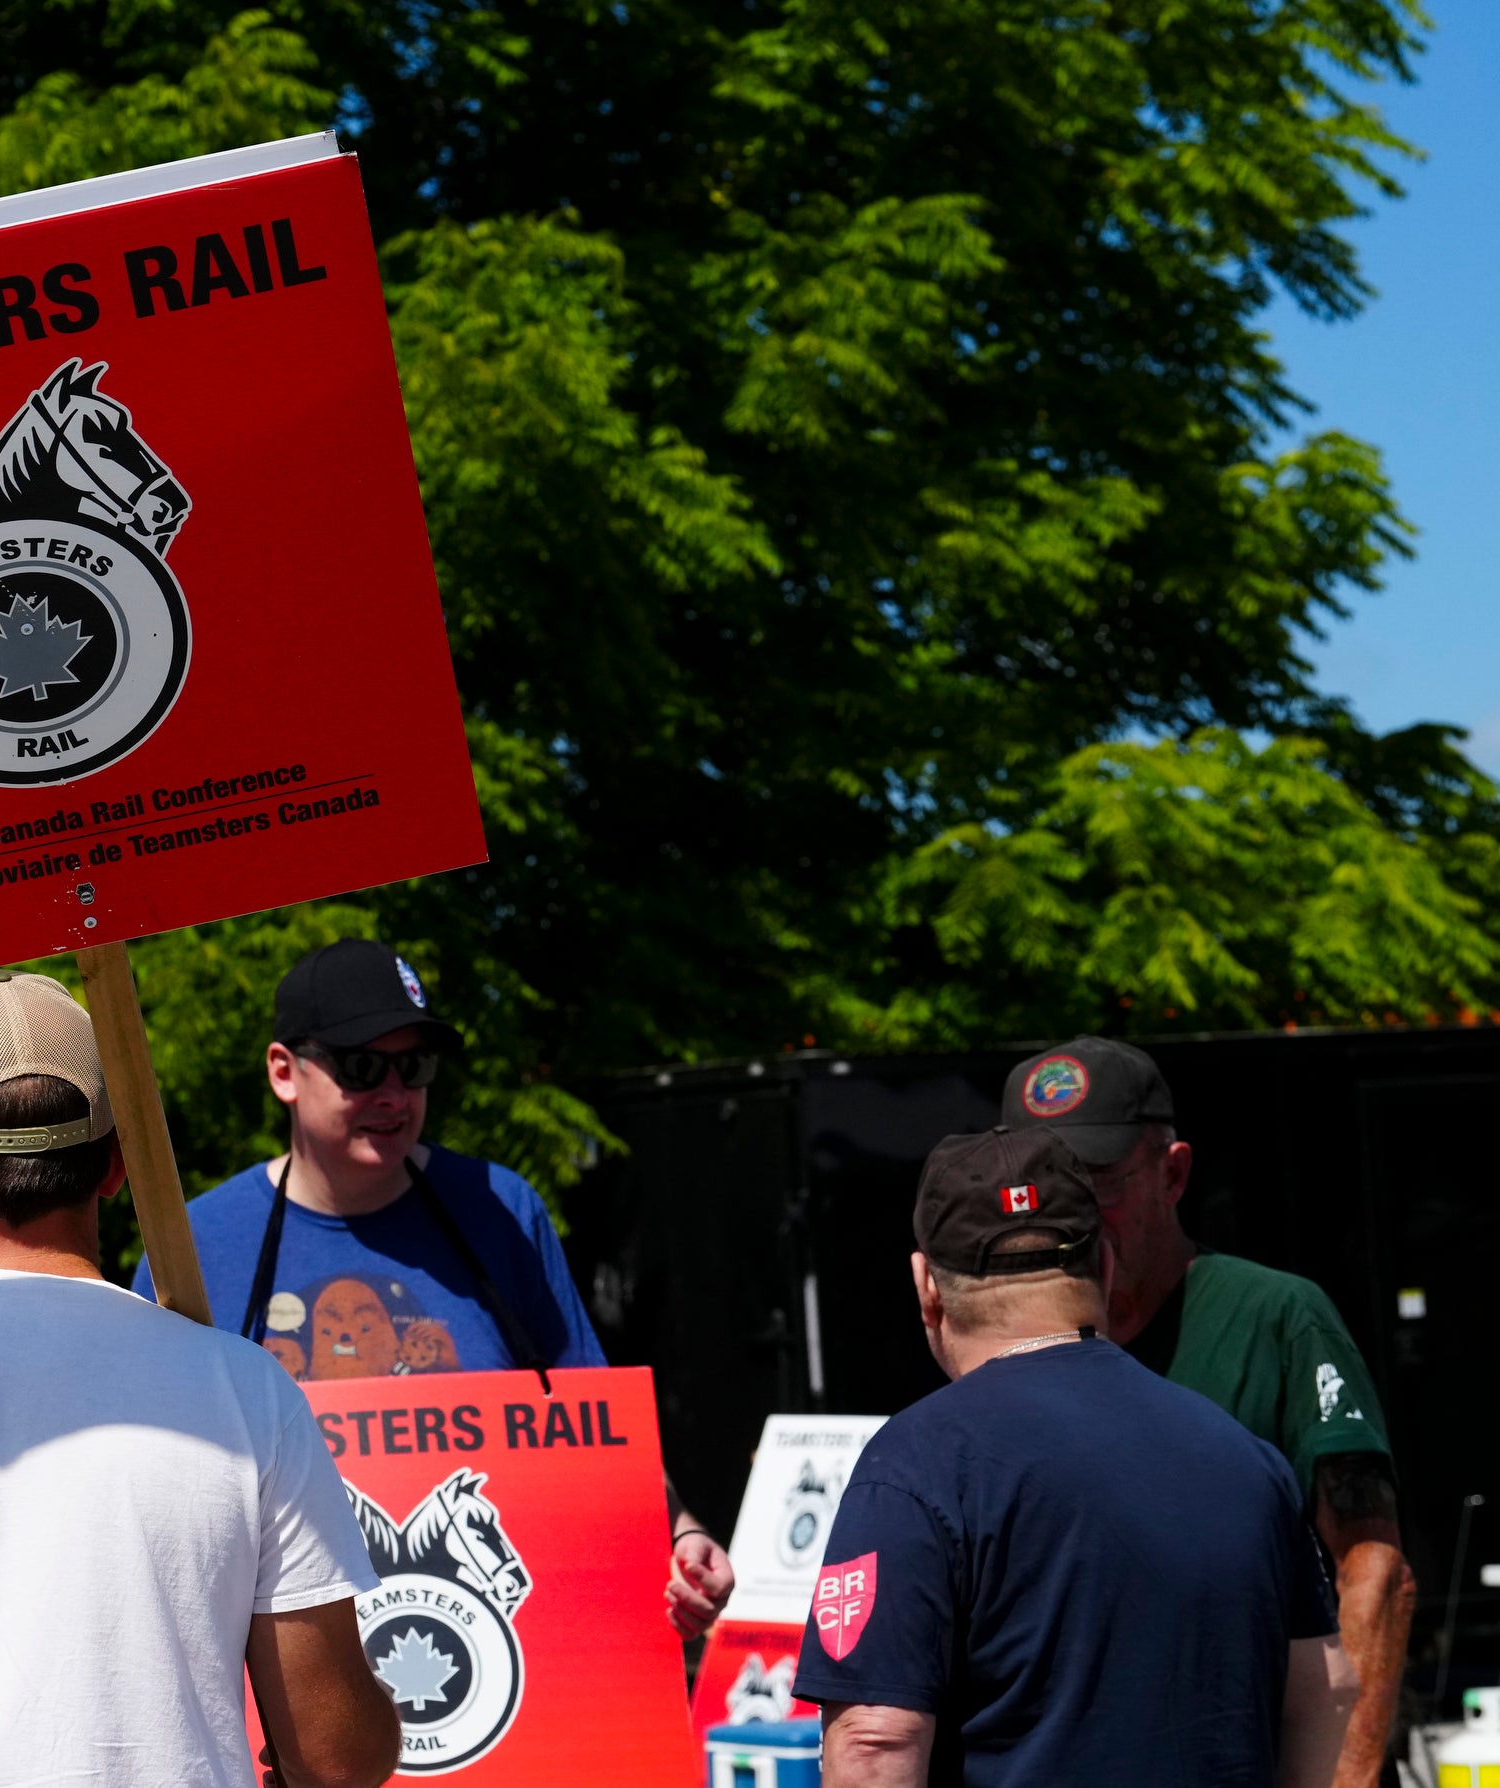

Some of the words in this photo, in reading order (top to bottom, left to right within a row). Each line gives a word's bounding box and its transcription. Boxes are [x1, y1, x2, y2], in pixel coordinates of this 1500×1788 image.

[124, 218, 327, 318] RAIL
[17, 729, 89, 757] RAIL
[90, 794, 145, 826] Rail
[152, 763, 306, 811] Conference
[88, 843, 122, 867] de
[128, 812, 270, 857] Teamsters
[277, 787, 380, 826] Canada
[316, 1405, 484, 1458] STERS
[504, 1400, 627, 1449] RAIL
[357, 1588, 477, 1626] EAMSTERS
[402, 1735, 447, 1751] RAIL
